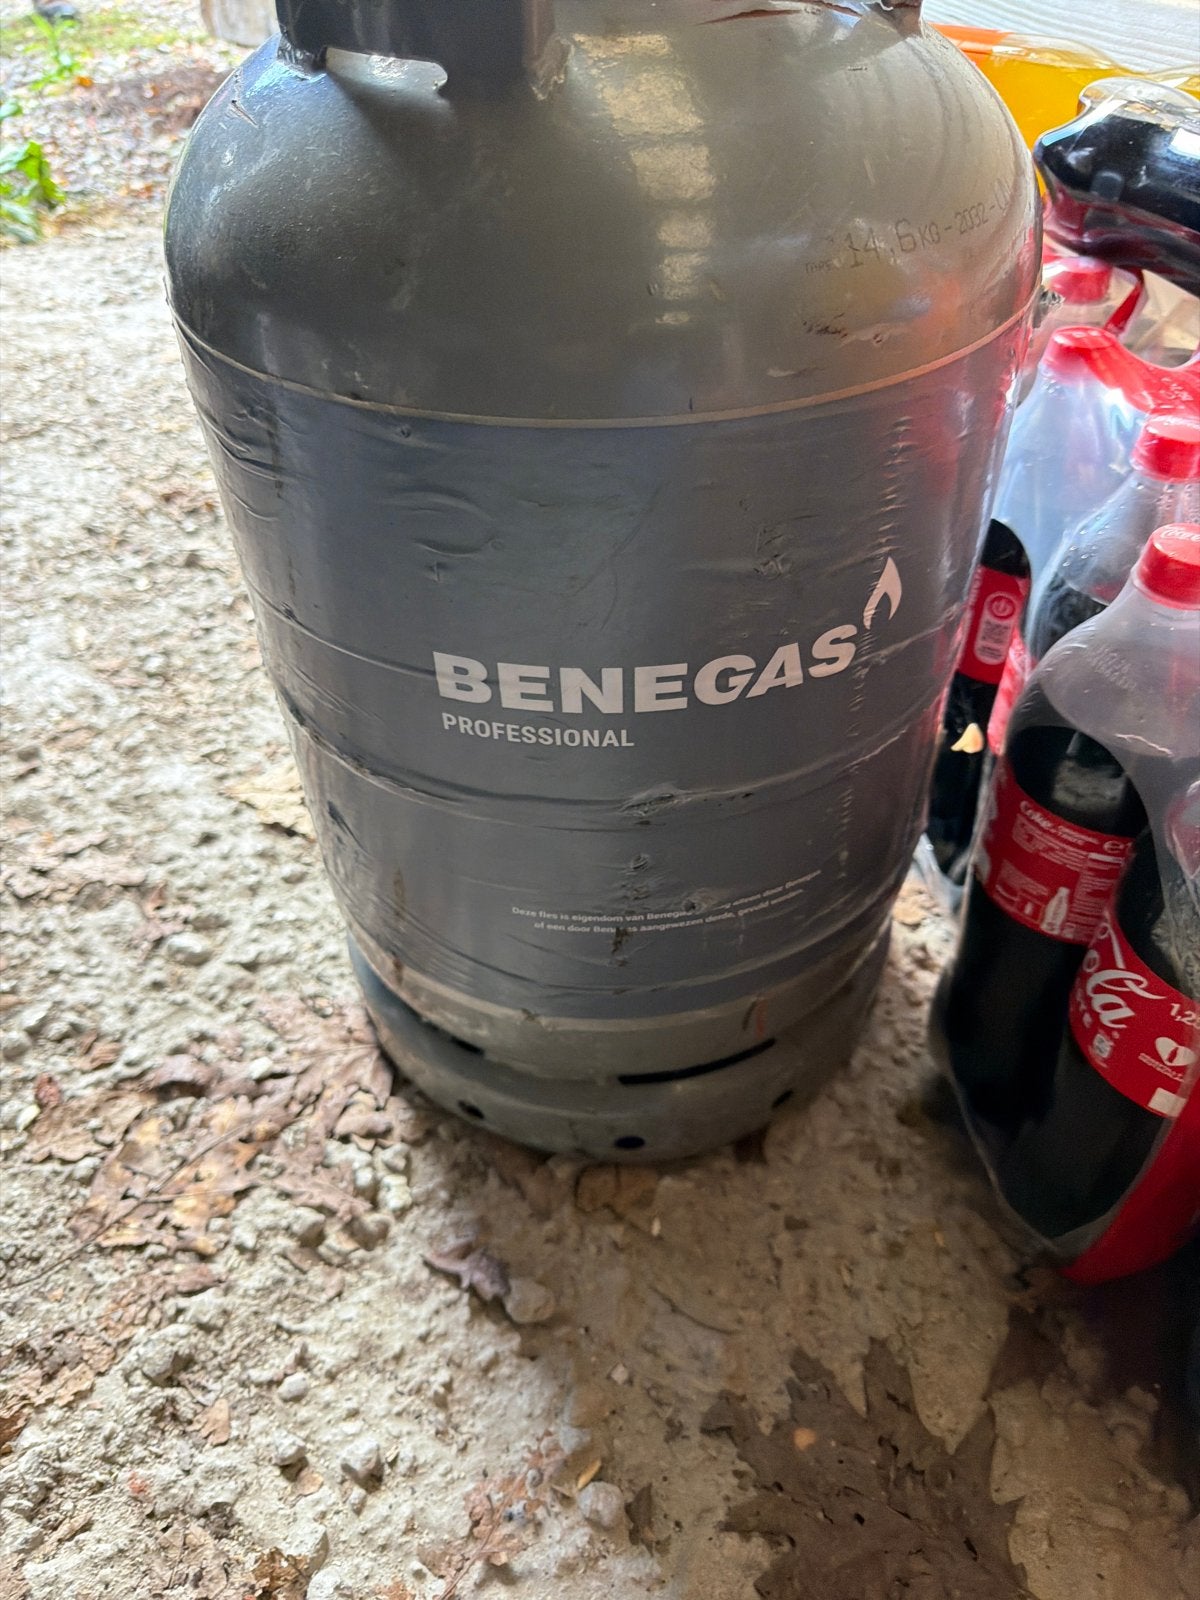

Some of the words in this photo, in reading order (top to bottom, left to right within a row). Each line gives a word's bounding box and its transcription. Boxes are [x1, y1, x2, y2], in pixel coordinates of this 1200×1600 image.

[432, 623, 859, 714] BENEGAS
[441, 712, 635, 748] PROFESSIONAL
[511, 906, 536, 917] Deze
[538, 911, 558, 920] fles
[560, 912, 569, 920] is
[571, 914, 624, 923] eigendom
[534, 921, 544, 929] of
[546, 923, 566, 931] een
[567, 923, 591, 933] door
